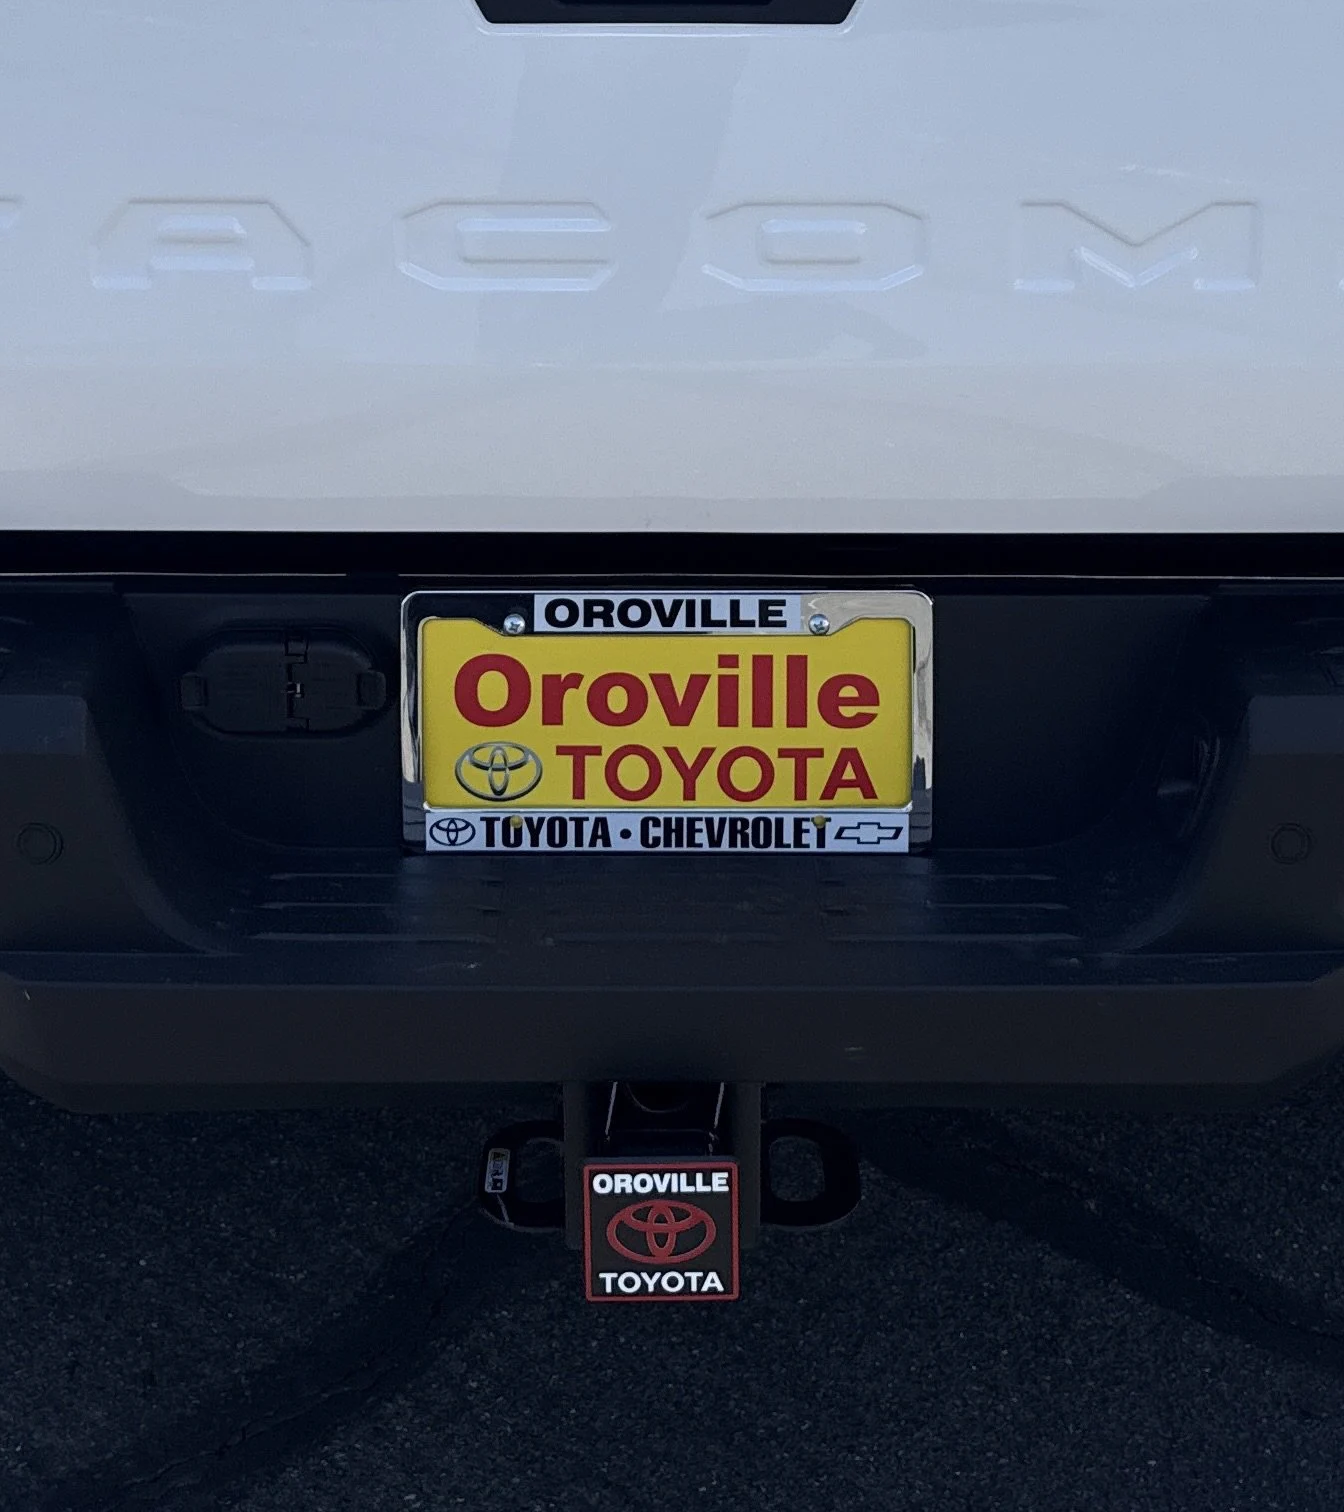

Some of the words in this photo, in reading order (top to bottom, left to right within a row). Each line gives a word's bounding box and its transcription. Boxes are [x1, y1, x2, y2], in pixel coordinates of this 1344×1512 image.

[544, 598, 788, 630] OROVILLE
[453, 653, 880, 729] Oroville
[556, 743, 879, 802] TOYOTA
[479, 816, 612, 850] TOYOTA
[639, 815, 832, 850] CHEVROLET
[592, 1171, 730, 1194] OROVILLE
[599, 1271, 725, 1294] TOYOTA
